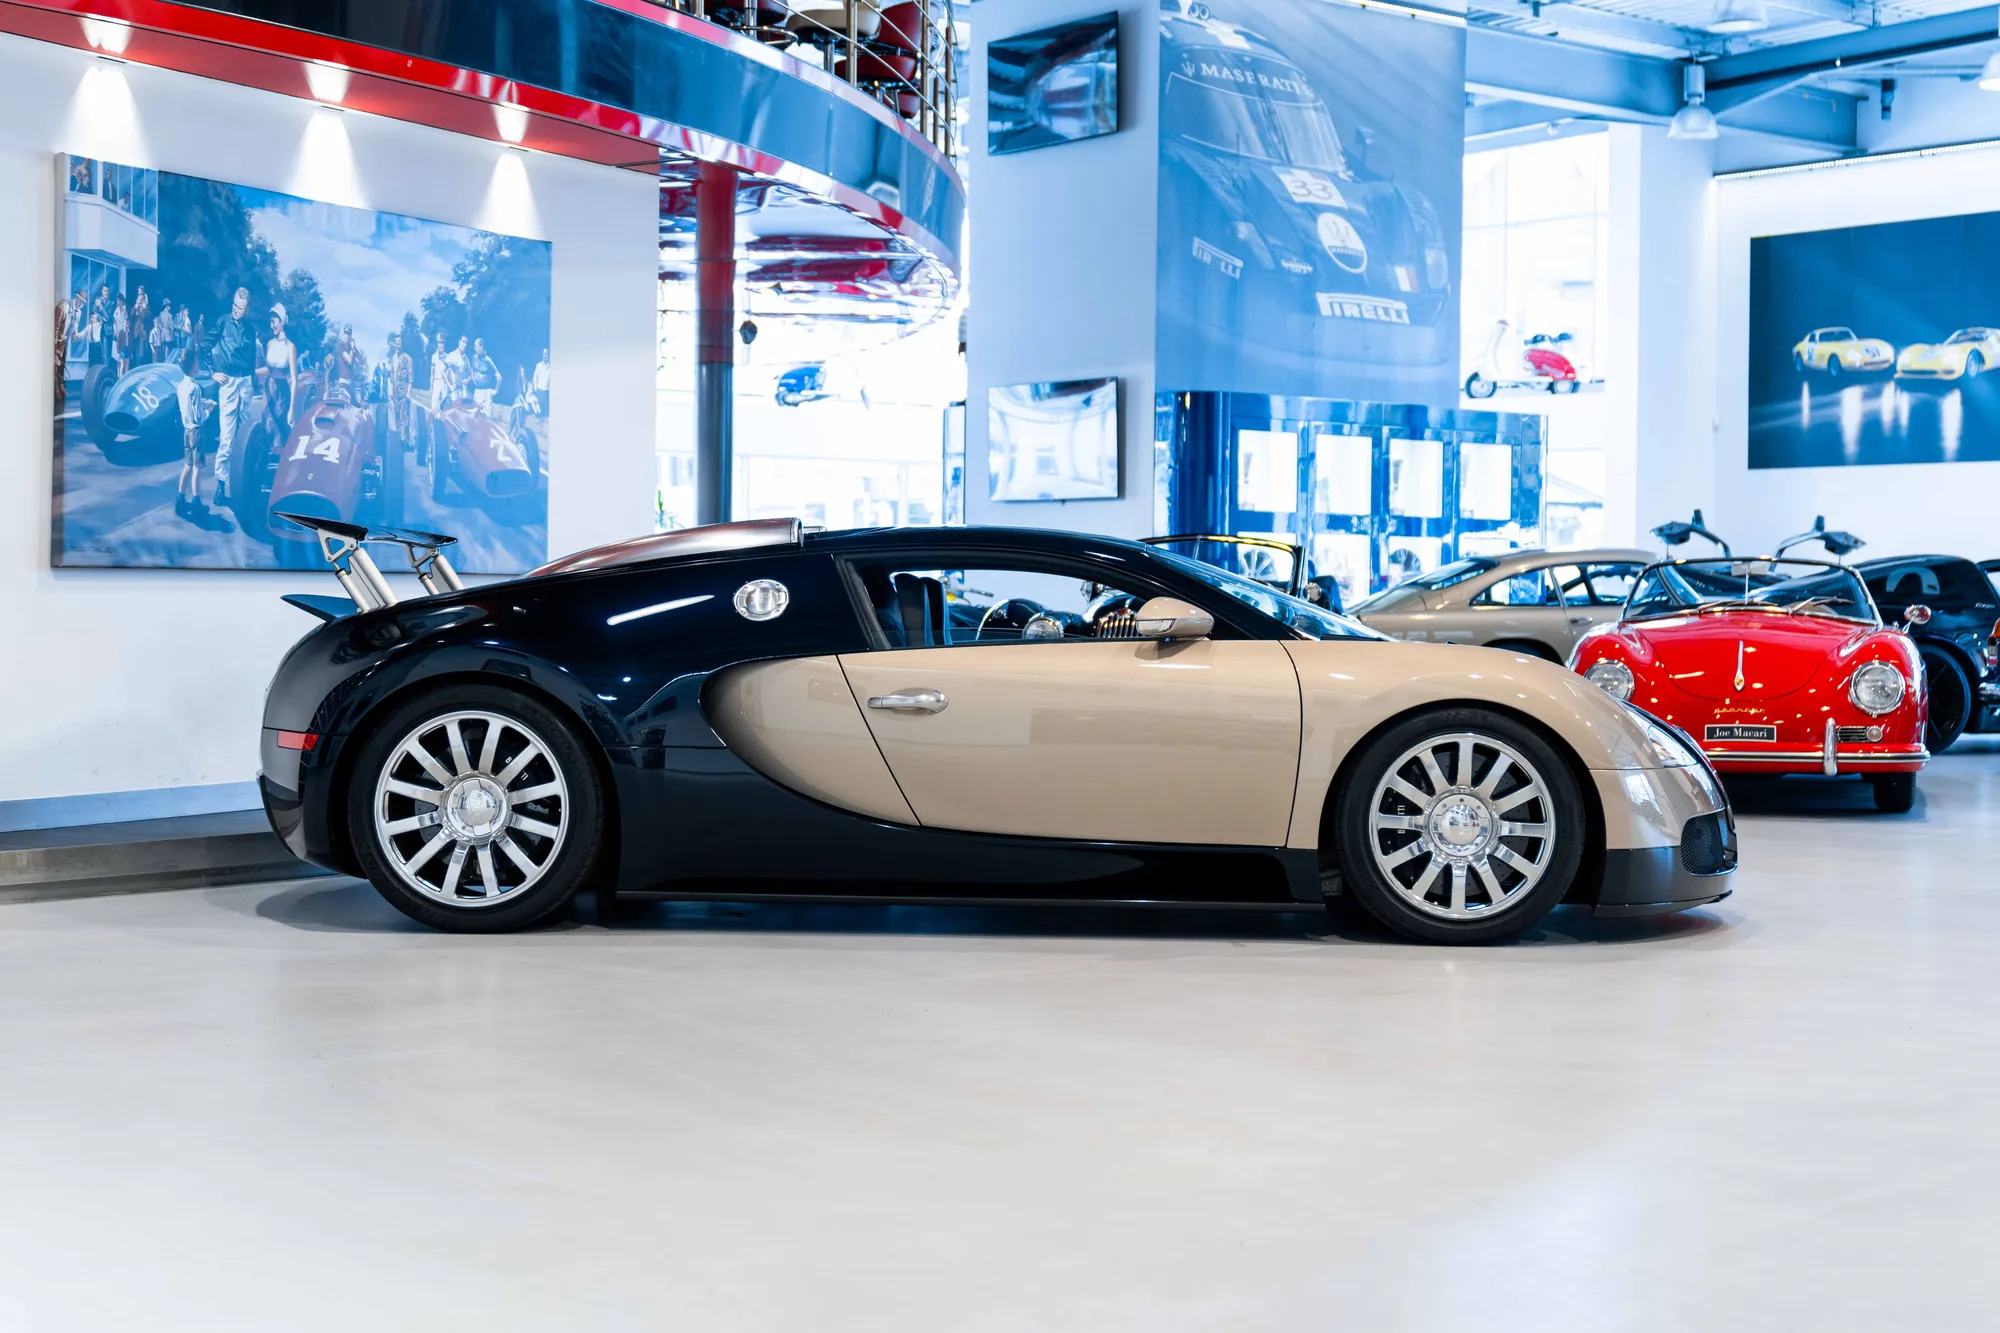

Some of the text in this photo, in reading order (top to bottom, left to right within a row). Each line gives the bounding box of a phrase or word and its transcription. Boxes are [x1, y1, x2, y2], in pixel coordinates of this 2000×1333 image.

[1200, 63, 1302, 94] MASERATI
[1290, 180, 1332, 200] 33
[1192, 236, 1244, 279] PIRLLI
[1315, 292, 1411, 324] PIRELLI
[131, 387, 159, 412] 18
[289, 435, 341, 464] 14
[1714, 728, 1767, 738] Joe Macari
